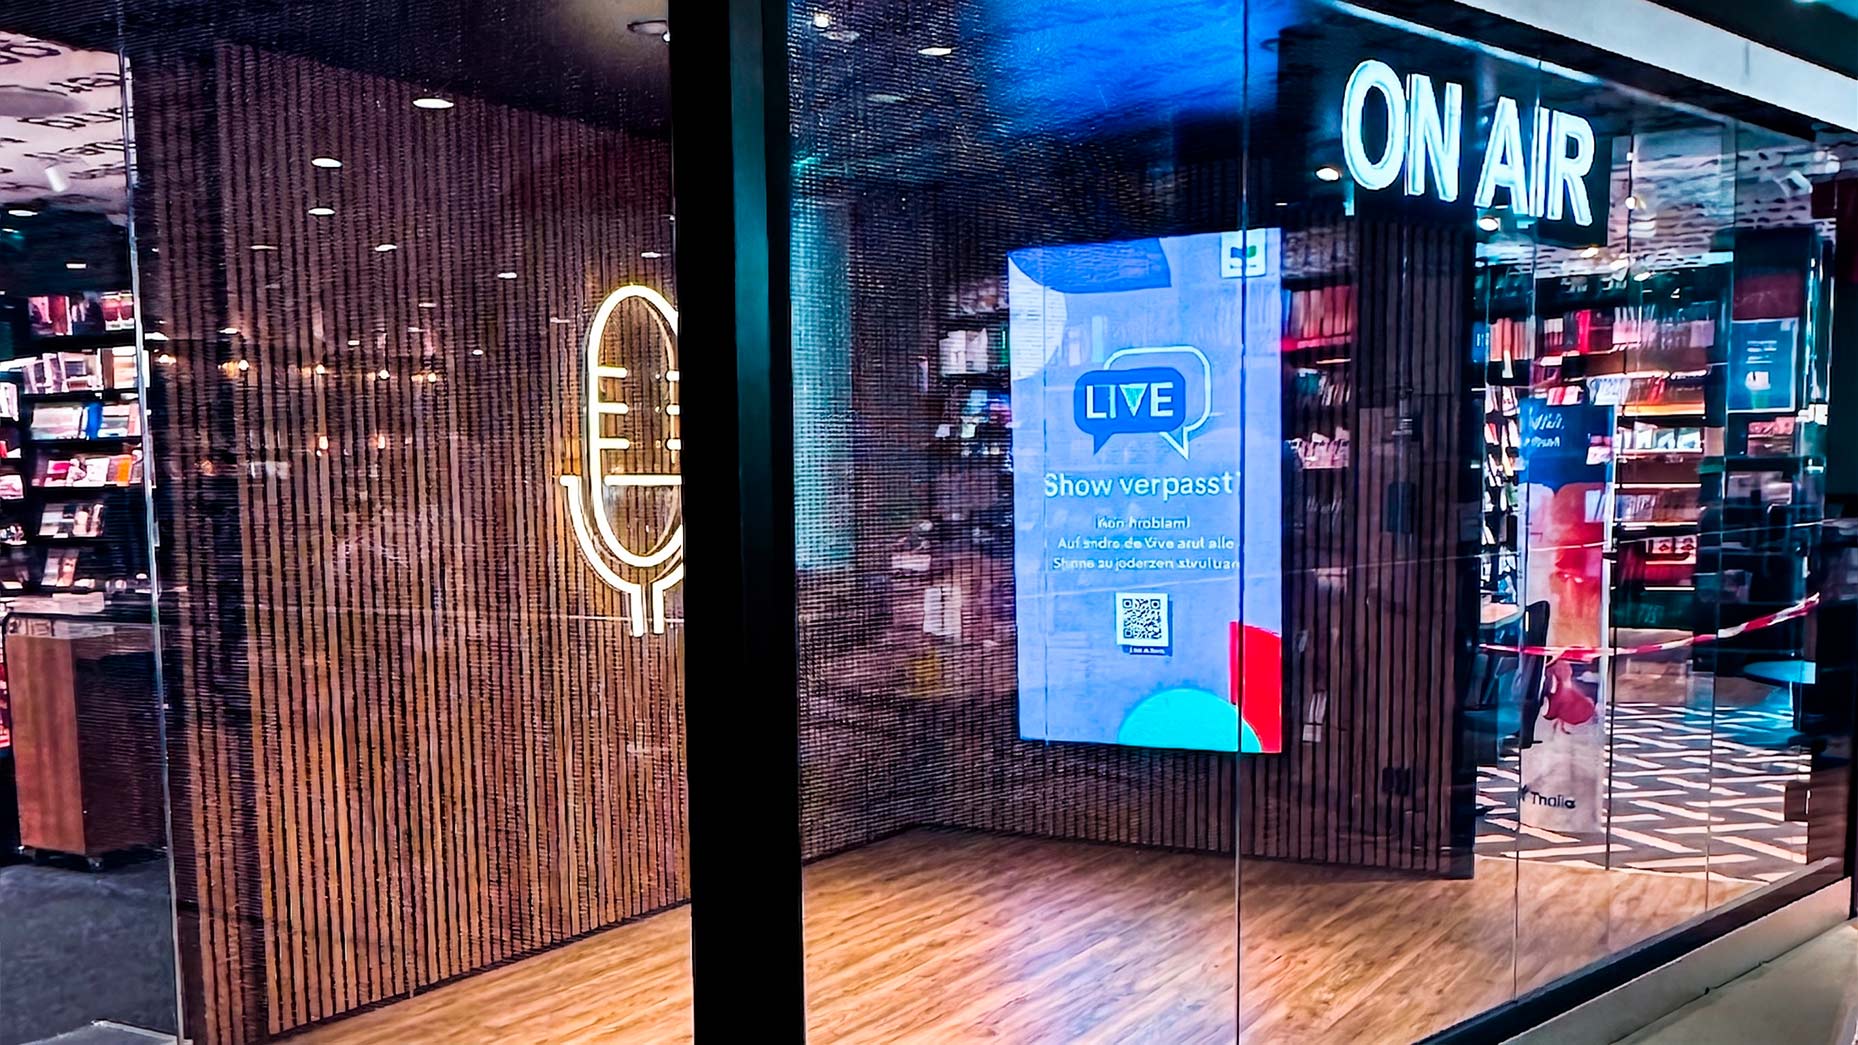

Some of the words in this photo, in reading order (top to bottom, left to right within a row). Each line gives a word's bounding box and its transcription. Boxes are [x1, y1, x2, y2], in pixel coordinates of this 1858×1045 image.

[1342, 59, 1463, 203] ON
[1474, 96, 1595, 227] AIR
[1086, 382, 1174, 419] LIVE
[1044, 472, 1113, 497] Show
[1120, 470, 1241, 502] verpasst
[1058, 535, 1081, 550] Auf
